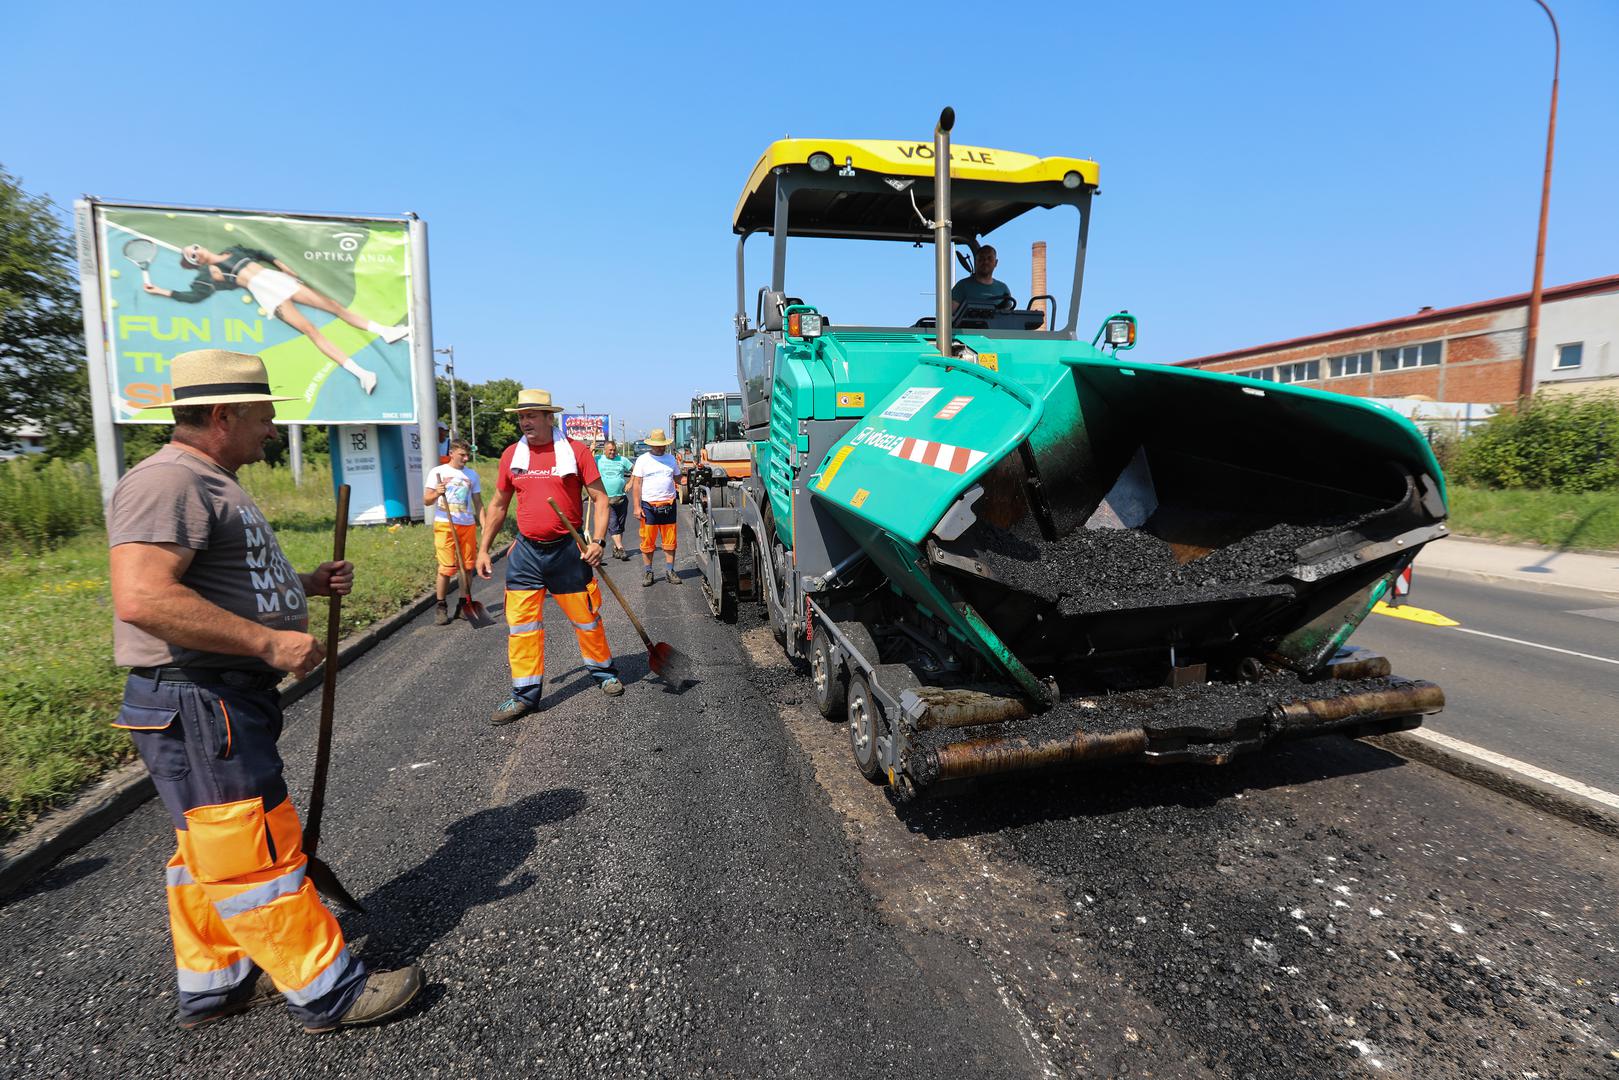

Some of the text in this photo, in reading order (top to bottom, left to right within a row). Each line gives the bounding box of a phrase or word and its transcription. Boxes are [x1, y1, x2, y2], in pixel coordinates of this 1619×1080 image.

[897, 143, 995, 165] VÖLE
[304, 251, 354, 262] OPTIKA
[119, 315, 264, 342] FUN IN
[123, 351, 180, 373] TH
